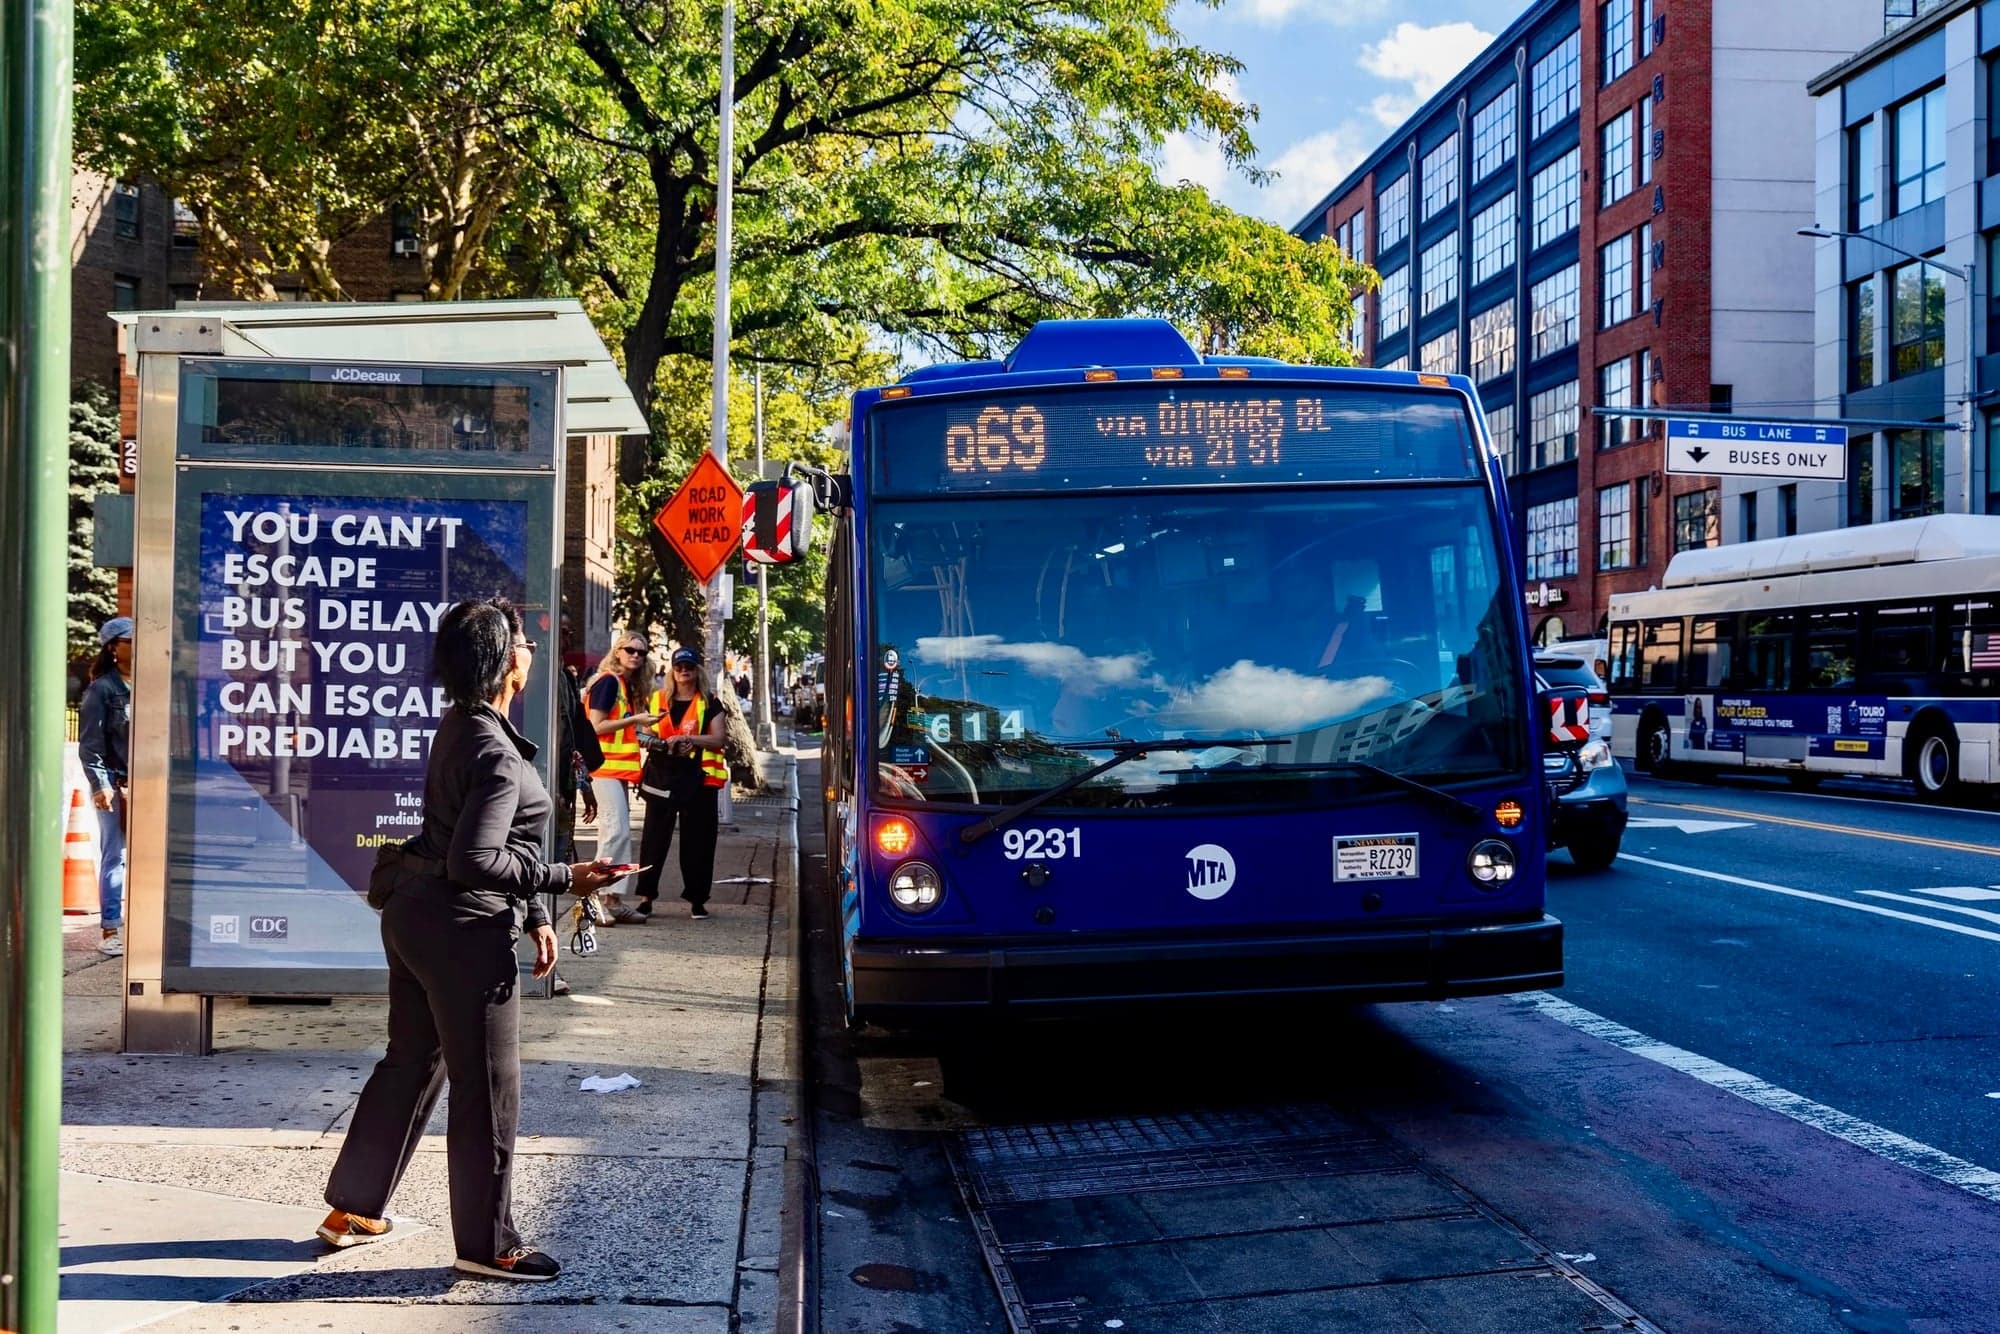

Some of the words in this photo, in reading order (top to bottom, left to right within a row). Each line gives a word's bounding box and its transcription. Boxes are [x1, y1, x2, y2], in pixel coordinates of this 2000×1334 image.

[331, 368, 400, 383] JCDecaux
[1296, 398, 1331, 431] BL
[946, 405, 1045, 472] Q69
[1722, 425, 1746, 437] BUS
[1759, 428, 1792, 440] LANE
[1206, 435, 1236, 465] 21
[1248, 433, 1281, 464] ST
[1729, 450, 1780, 465] BUSES
[1787, 453, 1828, 467] ONLY
[689, 486, 726, 503] ROAD
[688, 506, 725, 524] WORK
[224, 511, 318, 544] YOU
[331, 514, 462, 548] CAN'T
[682, 526, 730, 544] AHEAD
[224, 554, 377, 588] ESCAPE
[1548, 588, 1562, 602] BELL
[223, 596, 306, 629] BUS
[319, 599, 460, 632] DELAY
[222, 639, 302, 671] BUT
[311, 642, 406, 674] YOU
[219, 682, 310, 715] CAN
[325, 685, 455, 717] ESCAP
[1716, 706, 1736, 718] YOUR
[1859, 706, 1885, 717] TOURO
[218, 725, 437, 759] PREDIABET
[394, 792, 422, 807] Take
[1003, 827, 1081, 860] 9231
[1379, 848, 1412, 870] 2239
[1185, 857, 1227, 888] MTA
[213, 917, 237, 935] ad
[251, 918, 286, 933] CDC
